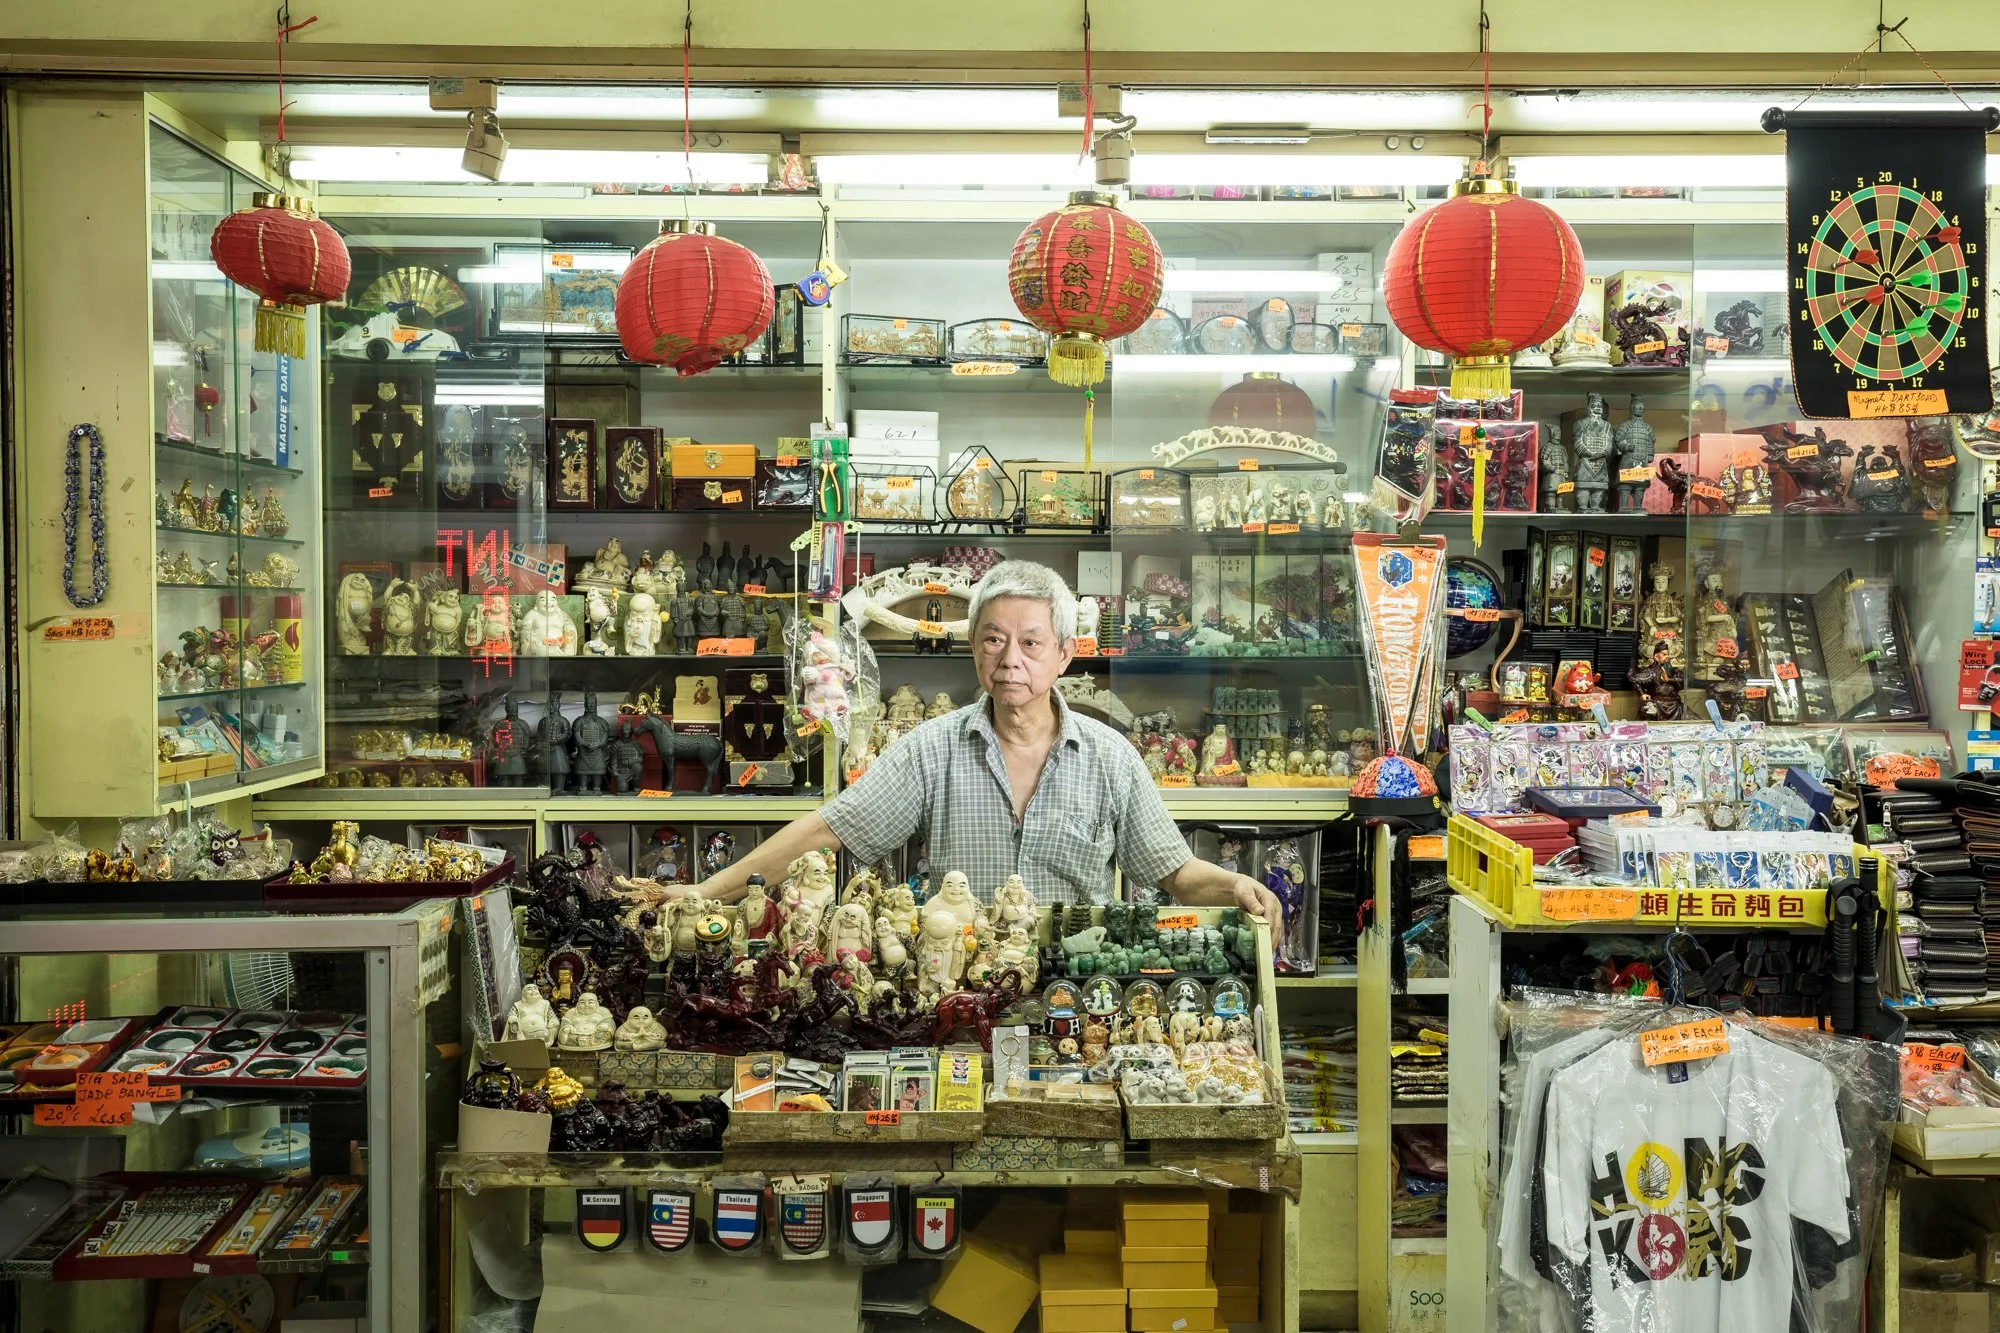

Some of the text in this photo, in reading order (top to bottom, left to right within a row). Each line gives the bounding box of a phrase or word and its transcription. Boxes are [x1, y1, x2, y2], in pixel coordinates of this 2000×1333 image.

[1878, 172, 1892, 182] 20
[1857, 178, 1864, 188] 5
[1912, 179, 1917, 188] 1
[1830, 191, 1841, 201] 12
[1931, 191, 1942, 201] 18
[1812, 216, 1819, 226] 9
[1951, 216, 1959, 226] 4
[1797, 243, 1808, 254] 14
[1966, 243, 1977, 254] 13
[1795, 278, 1803, 288] 11
[1971, 277, 1978, 287] 6
[1801, 310, 1808, 320] 8
[1967, 308, 1978, 319] 10
[363, 326, 370, 335] 9
[1812, 340, 1824, 350] 16
[1955, 337, 1966, 348] 15
[1833, 363, 1840, 373] 7
[1938, 361, 1945, 371] 2
[1856, 379, 1867, 389] 19
[1887, 382, 1894, 391] 3
[1912, 378, 1923, 388] 17
[813, 522, 822, 546] utter
[418, 567, 445, 591] UNO
[1378, 594, 1419, 717] HONG KONG
[1693, 1025, 1723, 1039] EACH
[1314, 1053, 1321, 1062] S
[1929, 1049, 1959, 1061] EACH
[78, 1073, 102, 1085] BIG
[118, 1088, 177, 1099] BANGLE
[856, 1194, 884, 1202] Singapore
